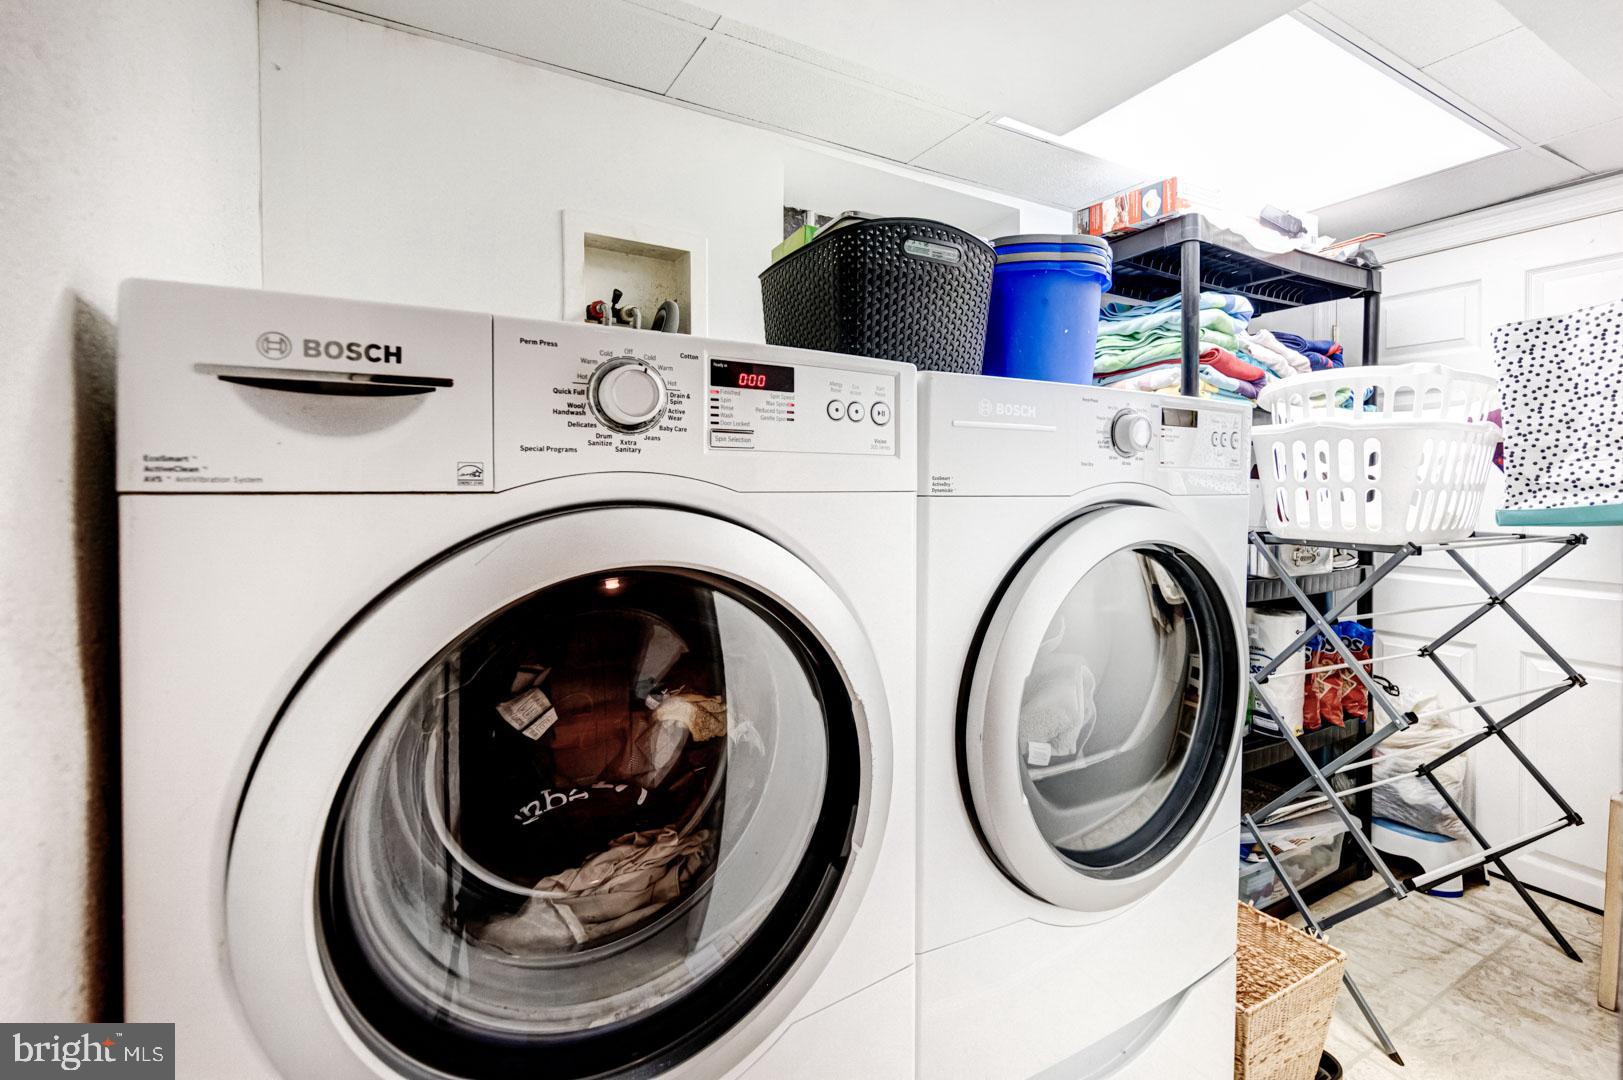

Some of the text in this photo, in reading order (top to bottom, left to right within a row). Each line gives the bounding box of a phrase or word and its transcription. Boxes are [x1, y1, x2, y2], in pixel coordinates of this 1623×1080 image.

[519, 337, 558, 348] Perm Press
[303, 339, 403, 364] BOSCH
[599, 349, 613, 358] Cold
[643, 353, 657, 361] Cold
[680, 352, 699, 361] Cotton
[580, 357, 598, 365] Warm
[658, 364, 674, 372] Warm
[552, 387, 572, 395] Quick
[720, 388, 741, 396] Finished
[567, 402, 586, 410] Wool/
[996, 402, 1037, 418] BOSCH
[552, 408, 586, 416] Handwash
[567, 421, 597, 429] Delicates
[659, 425, 673, 433] Baby
[520, 444, 578, 454] Special Programs
[615, 446, 642, 455] Sanitary
